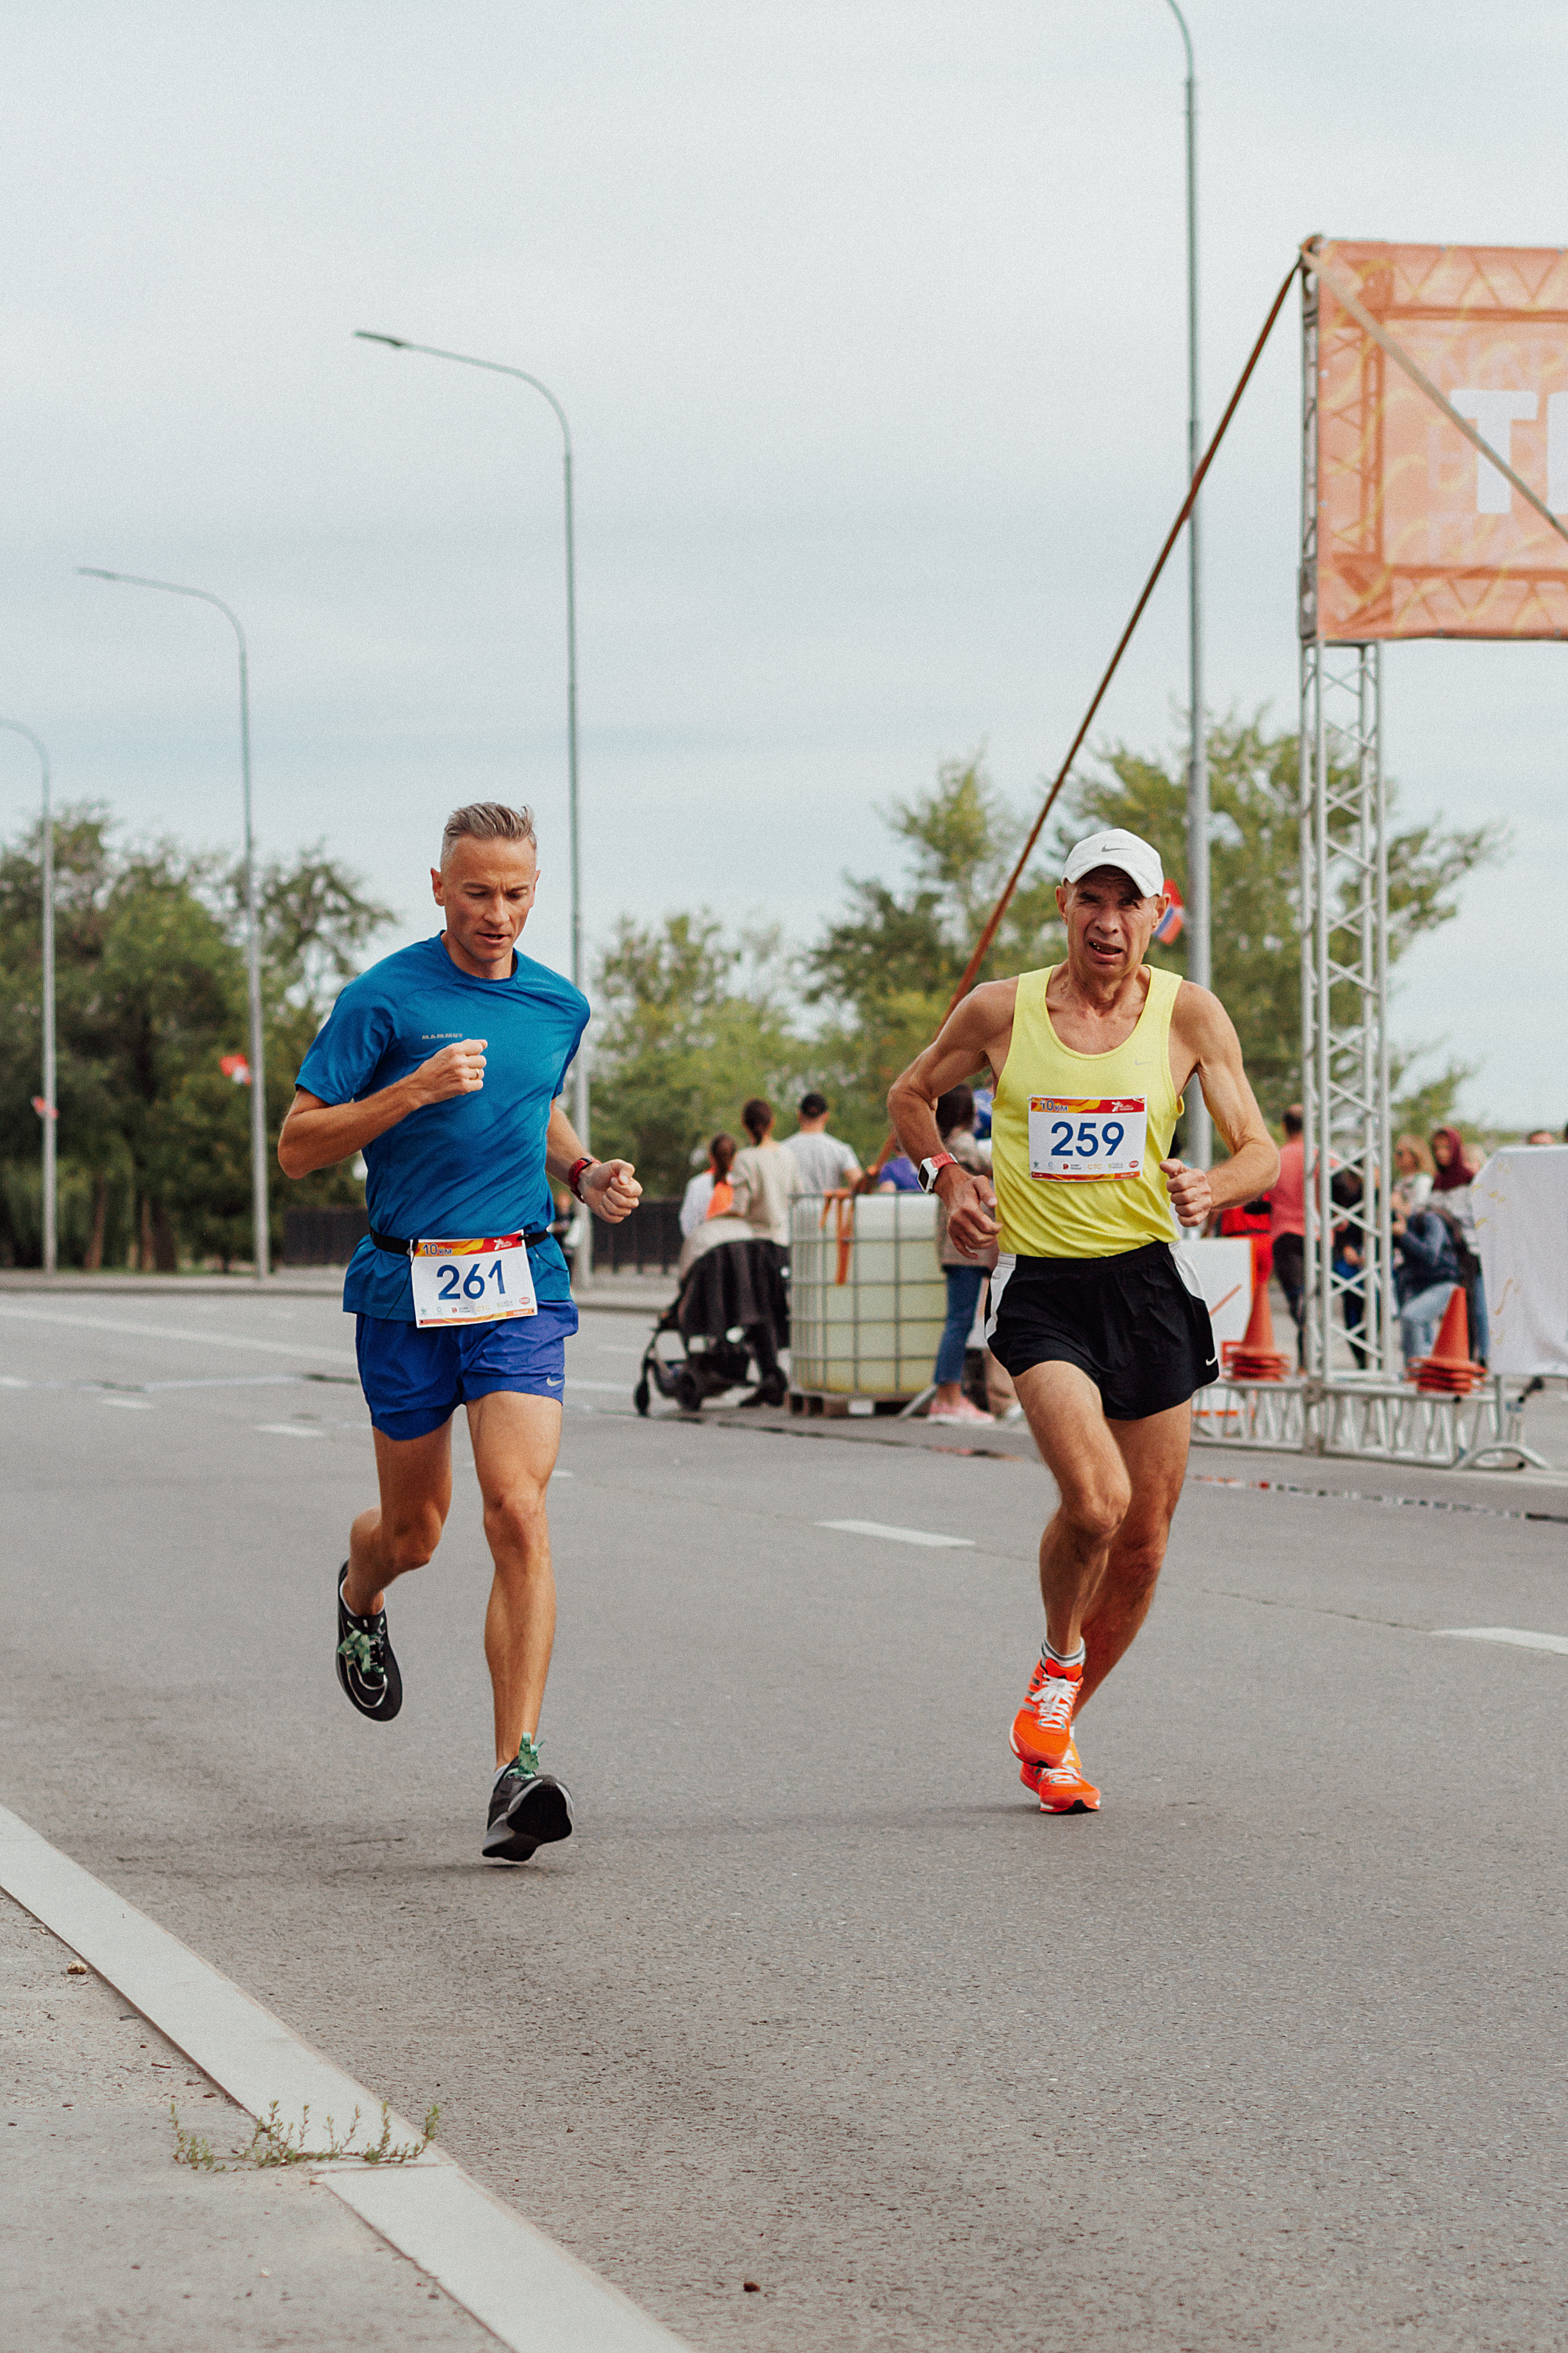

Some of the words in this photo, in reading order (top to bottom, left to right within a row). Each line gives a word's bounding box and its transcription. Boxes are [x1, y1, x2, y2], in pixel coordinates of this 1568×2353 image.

[1039, 1100, 1054, 1111] 10
[1051, 1121, 1125, 1157] 259
[422, 1243, 438, 1256] 10
[436, 1260, 506, 1301] 261
